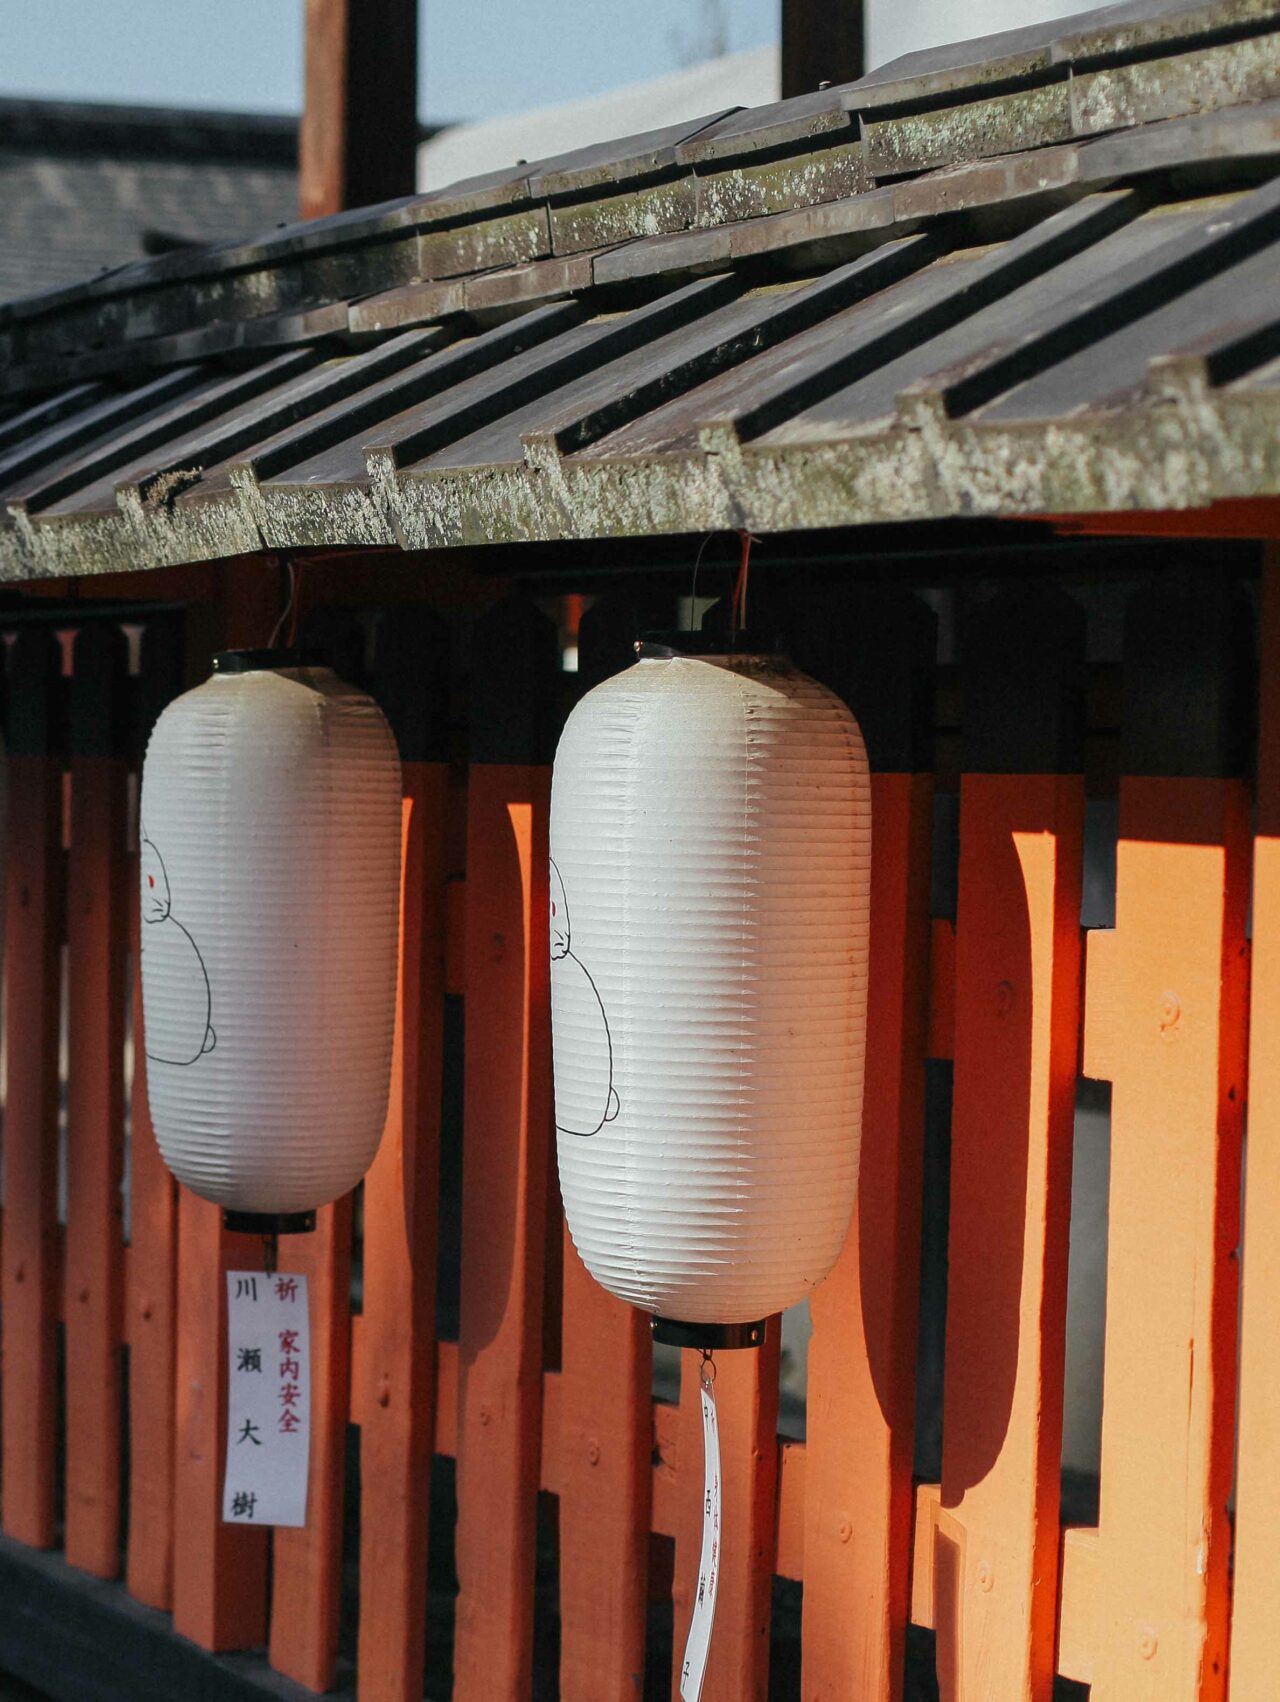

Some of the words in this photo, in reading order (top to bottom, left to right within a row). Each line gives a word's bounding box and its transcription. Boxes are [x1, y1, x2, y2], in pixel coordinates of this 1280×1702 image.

[275, 1277, 298, 1303] 祈
[231, 1277, 262, 1518] 川瀬大樹
[278, 1329, 301, 1433] 家内安全
